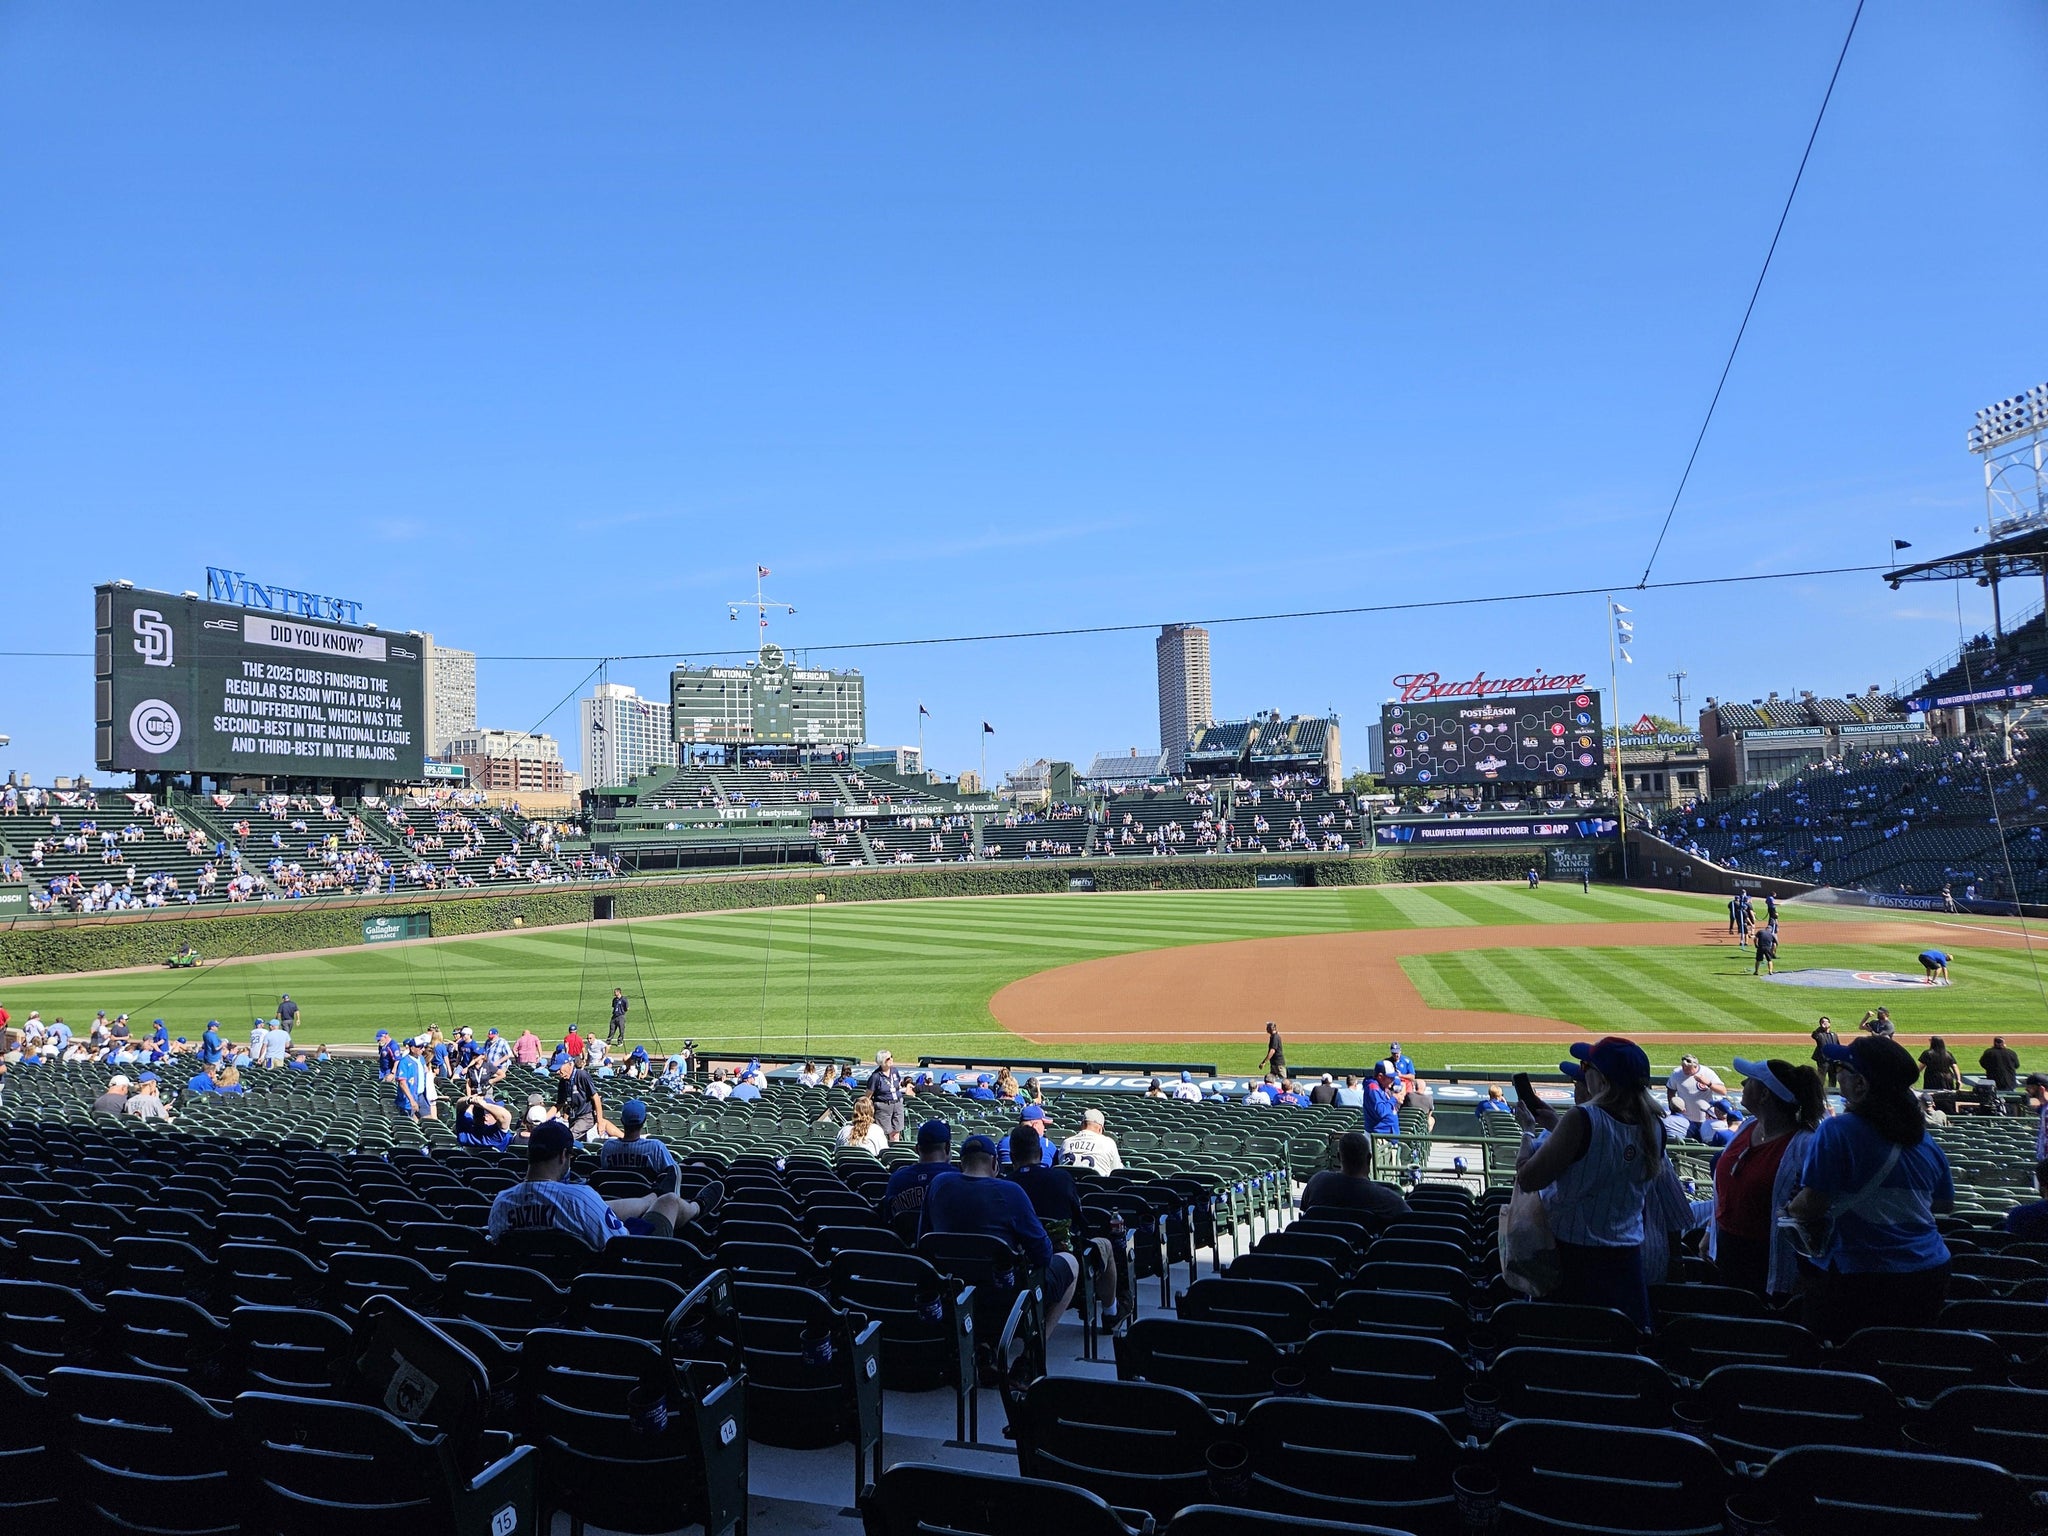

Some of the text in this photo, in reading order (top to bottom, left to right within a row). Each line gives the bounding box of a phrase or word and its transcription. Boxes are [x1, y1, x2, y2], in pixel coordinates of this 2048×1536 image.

[206, 566, 362, 624] WINTRUST
[271, 625, 364, 654] DID YOU KNOW?
[242, 661, 388, 693] THE 2025 CUBS FINISHED THE
[712, 669, 752, 679] NATIONAL
[792, 672, 830, 680] AMERICAN
[1393, 668, 1586, 703] Budweiser
[226, 678, 402, 711] REGULAR SEASON WITH A PLUS-144
[224, 697, 403, 728] RUN DIFFERENTIAL, WHICH WAS THE
[1460, 708, 1516, 718] POSTSEASON
[213, 716, 411, 745] SECOND-BEST IN THE NATIONAL LEAGUE
[1602, 734, 1652, 747] enamin
[1657, 733, 1702, 744] Moore
[232, 736, 398, 761] AND THIRD-BEST IN THE MAJORS.
[718, 808, 747, 819] YETI
[762, 808, 802, 818] tastytrade
[844, 805, 880, 813] GRAINGER
[964, 804, 999, 812] Advocate
[1422, 824, 1569, 838] FOLLOW EVERY MOMENT IN OCTOBER APP
[1071, 878, 1092, 886] Hefty
[0, 894, 22, 902] OSCH
[1878, 896, 1931, 909] POSTSEASON
[366, 924, 400, 935] Gallagher
[1070, 1141, 1096, 1152] POZZI
[606, 1153, 648, 1168] SWANSON
[507, 1204, 556, 1230] SUZUKI
[724, 1424, 734, 1438] 14
[496, 1512, 512, 1532] 15
